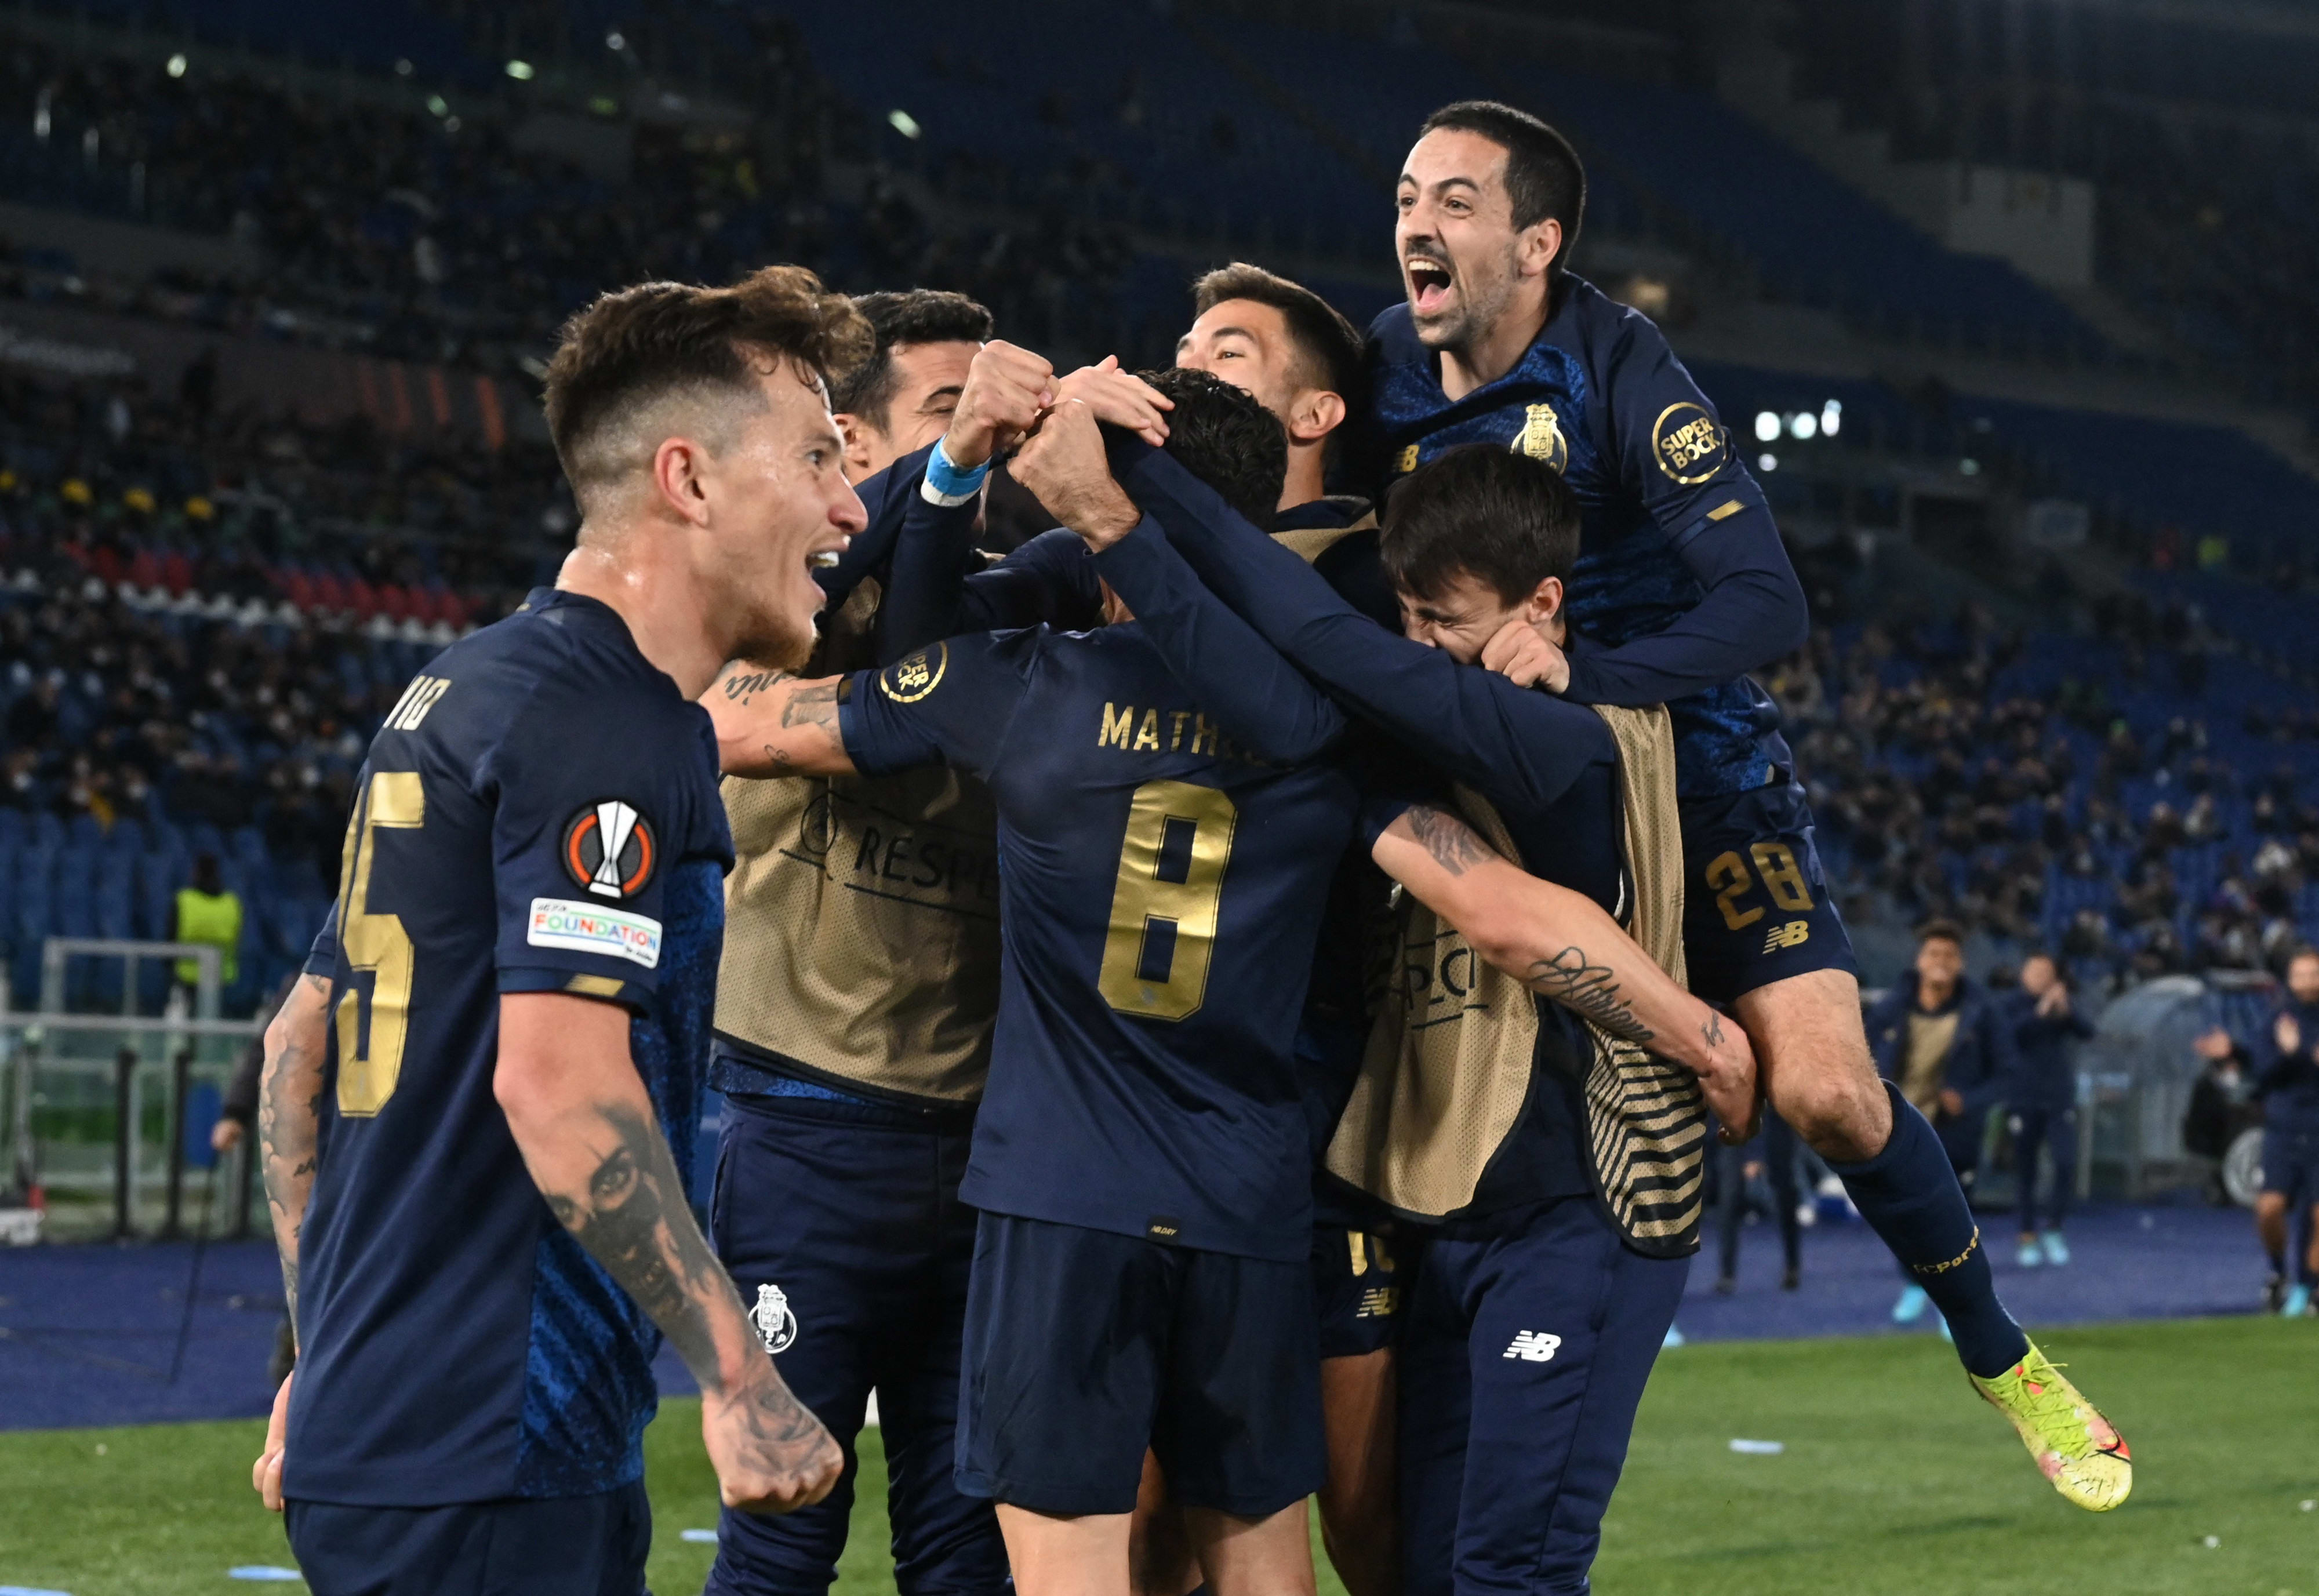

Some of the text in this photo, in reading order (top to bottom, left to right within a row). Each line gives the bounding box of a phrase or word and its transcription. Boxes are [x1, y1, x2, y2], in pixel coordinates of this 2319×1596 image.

[1661, 417, 1714, 456] SUPER
[1672, 432, 1721, 469] BOCK
[1097, 701, 1271, 766] MATH
[1097, 779, 1238, 1023] 8
[1705, 842, 1815, 931] 28
[336, 772, 426, 1118] 5
[535, 913, 657, 950] FOUNDATION
